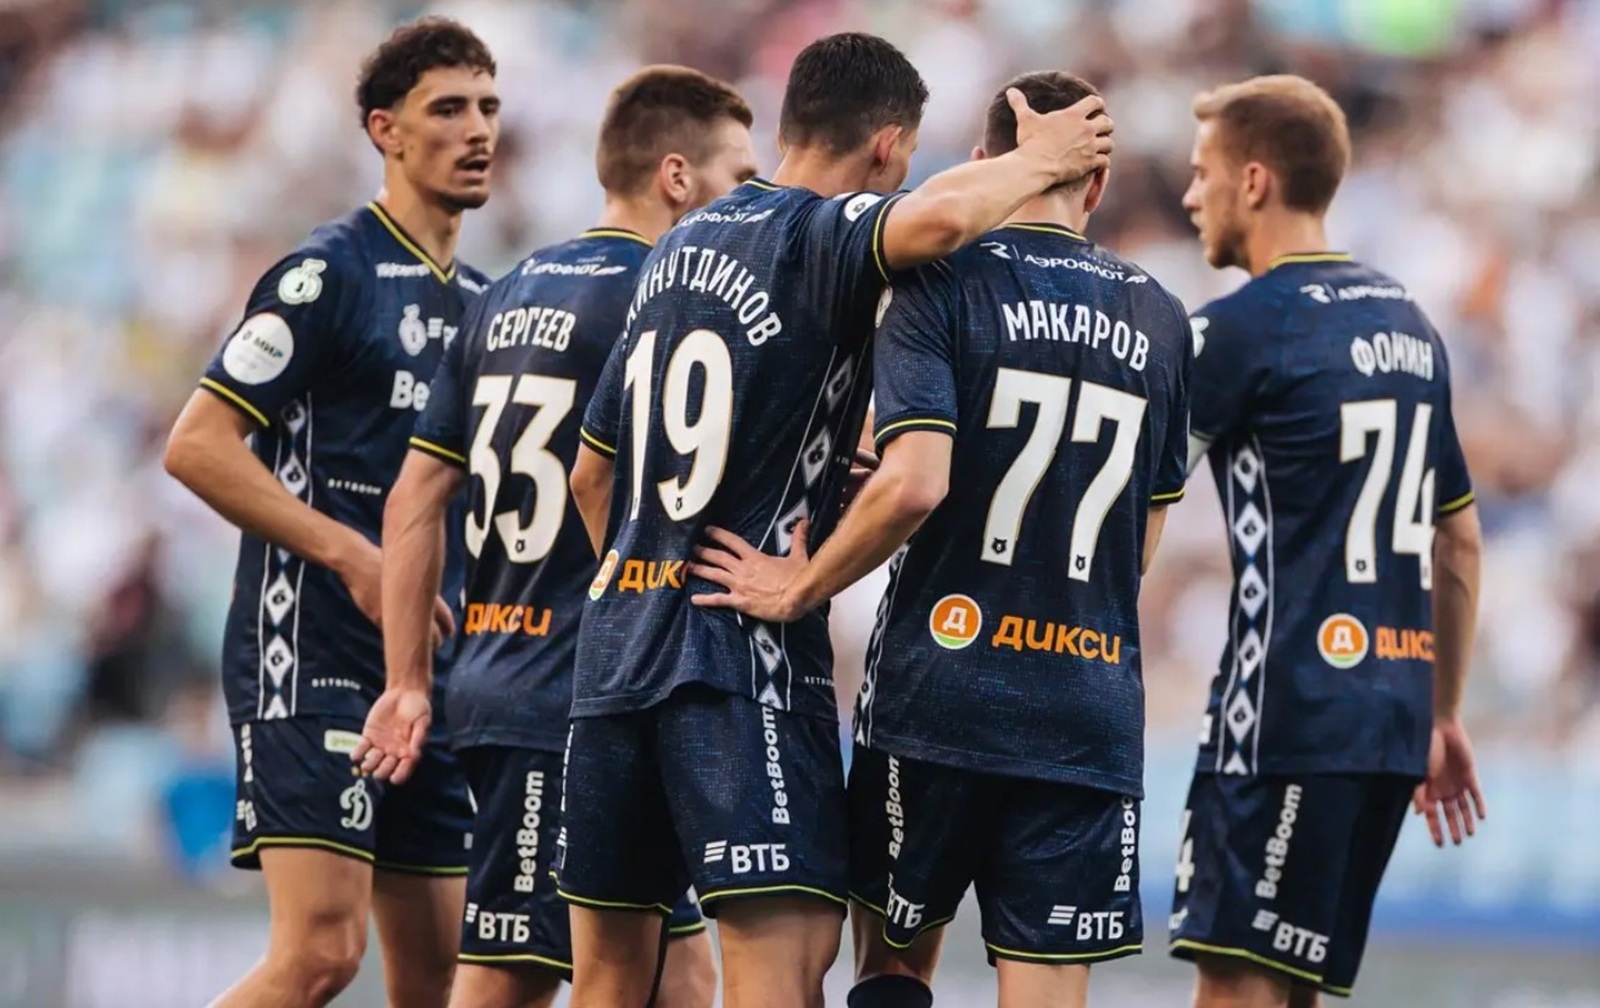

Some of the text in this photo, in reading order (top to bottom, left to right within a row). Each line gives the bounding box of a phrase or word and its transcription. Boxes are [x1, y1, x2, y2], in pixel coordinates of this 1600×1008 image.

[1024, 254, 1125, 281] АЭРОФЛОТ
[486, 306, 577, 352] СЕРГЕЕВ
[1002, 300, 1149, 371] МАКАРОВ
[1350, 331, 1433, 381] ФОМИН
[389, 370, 430, 411] Be
[624, 329, 734, 522] 19
[465, 373, 577, 564] 33
[980, 367, 1149, 583] 77
[1340, 399, 1436, 590] 74
[513, 770, 544, 892] BetBoom
[730, 843, 790, 874] ВТБ
[1113, 796, 1136, 892] BetBoo
[1255, 784, 1303, 899] BetBoom
[478, 911, 530, 942] ВТБ
[1076, 911, 1124, 940] ВТБ
[1272, 921, 1330, 963] ВТБ
